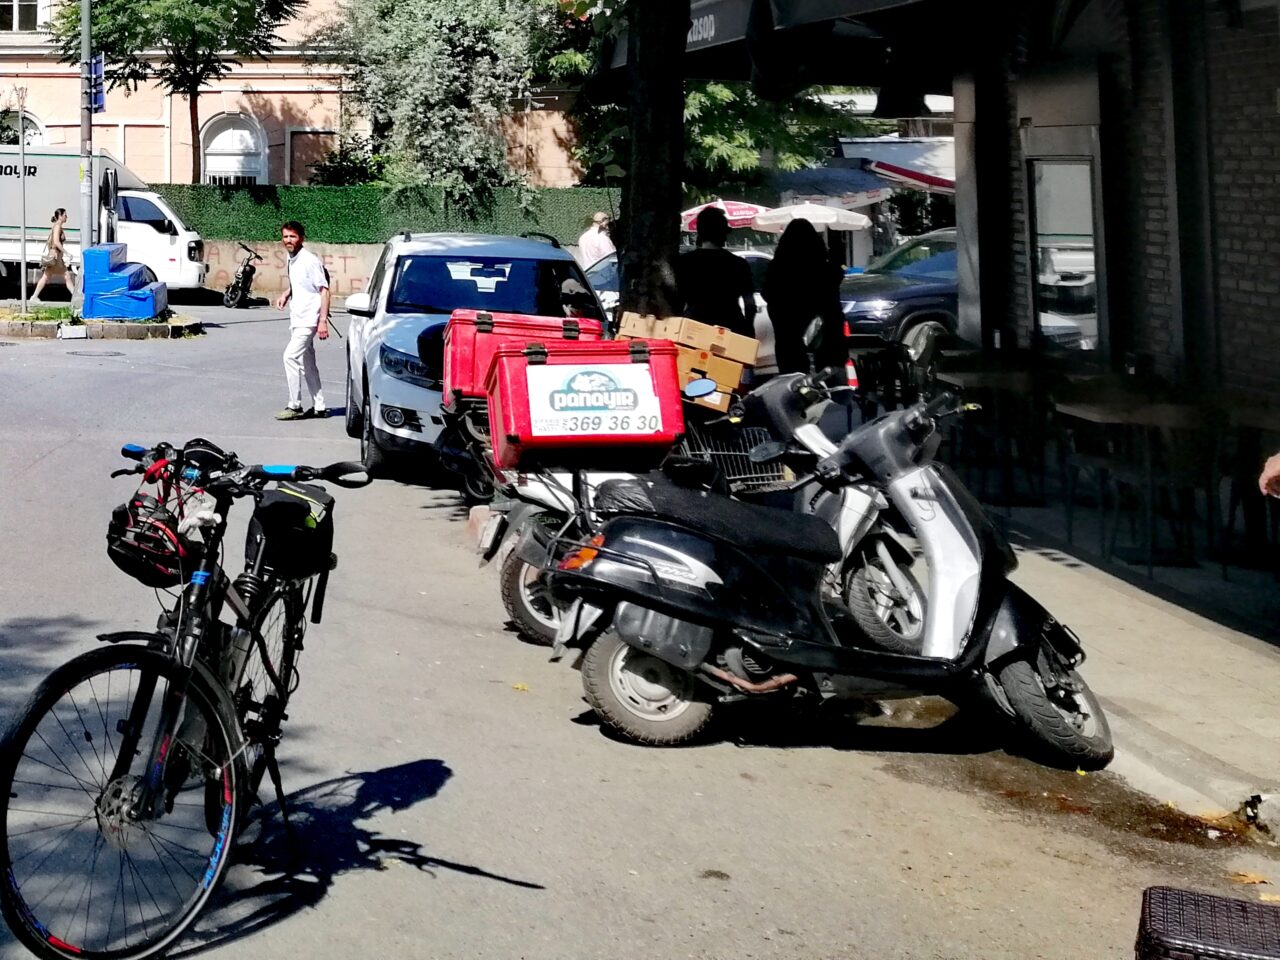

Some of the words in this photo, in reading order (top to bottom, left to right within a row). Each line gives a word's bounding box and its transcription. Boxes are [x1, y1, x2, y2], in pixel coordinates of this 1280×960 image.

[569, 416, 602, 432] 369
[608, 415, 631, 431] 36
[636, 415, 659, 431] 30
